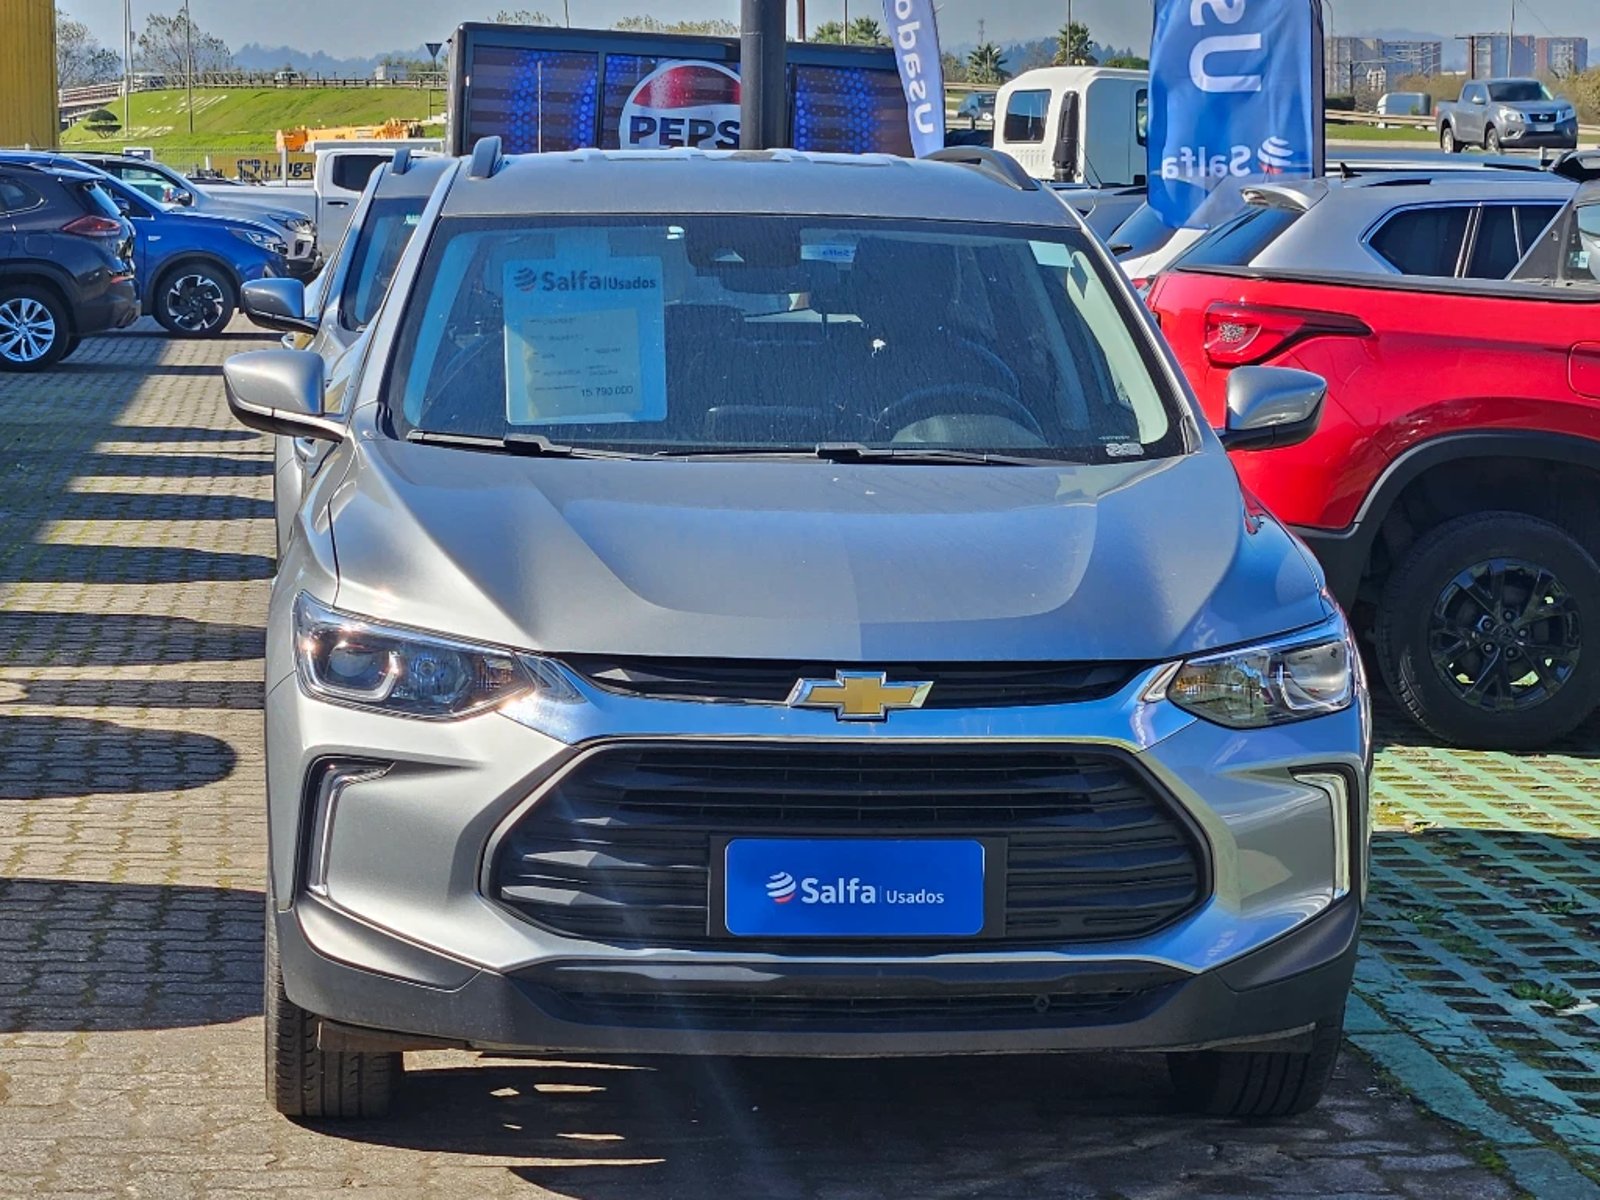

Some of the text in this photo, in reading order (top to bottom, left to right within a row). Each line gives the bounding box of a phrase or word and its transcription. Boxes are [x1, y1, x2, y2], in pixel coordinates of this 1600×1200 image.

[629, 115, 741, 150] PEPS
[541, 269, 657, 292] Salfa Usados
[800, 877, 945, 904] Salfa Usados
